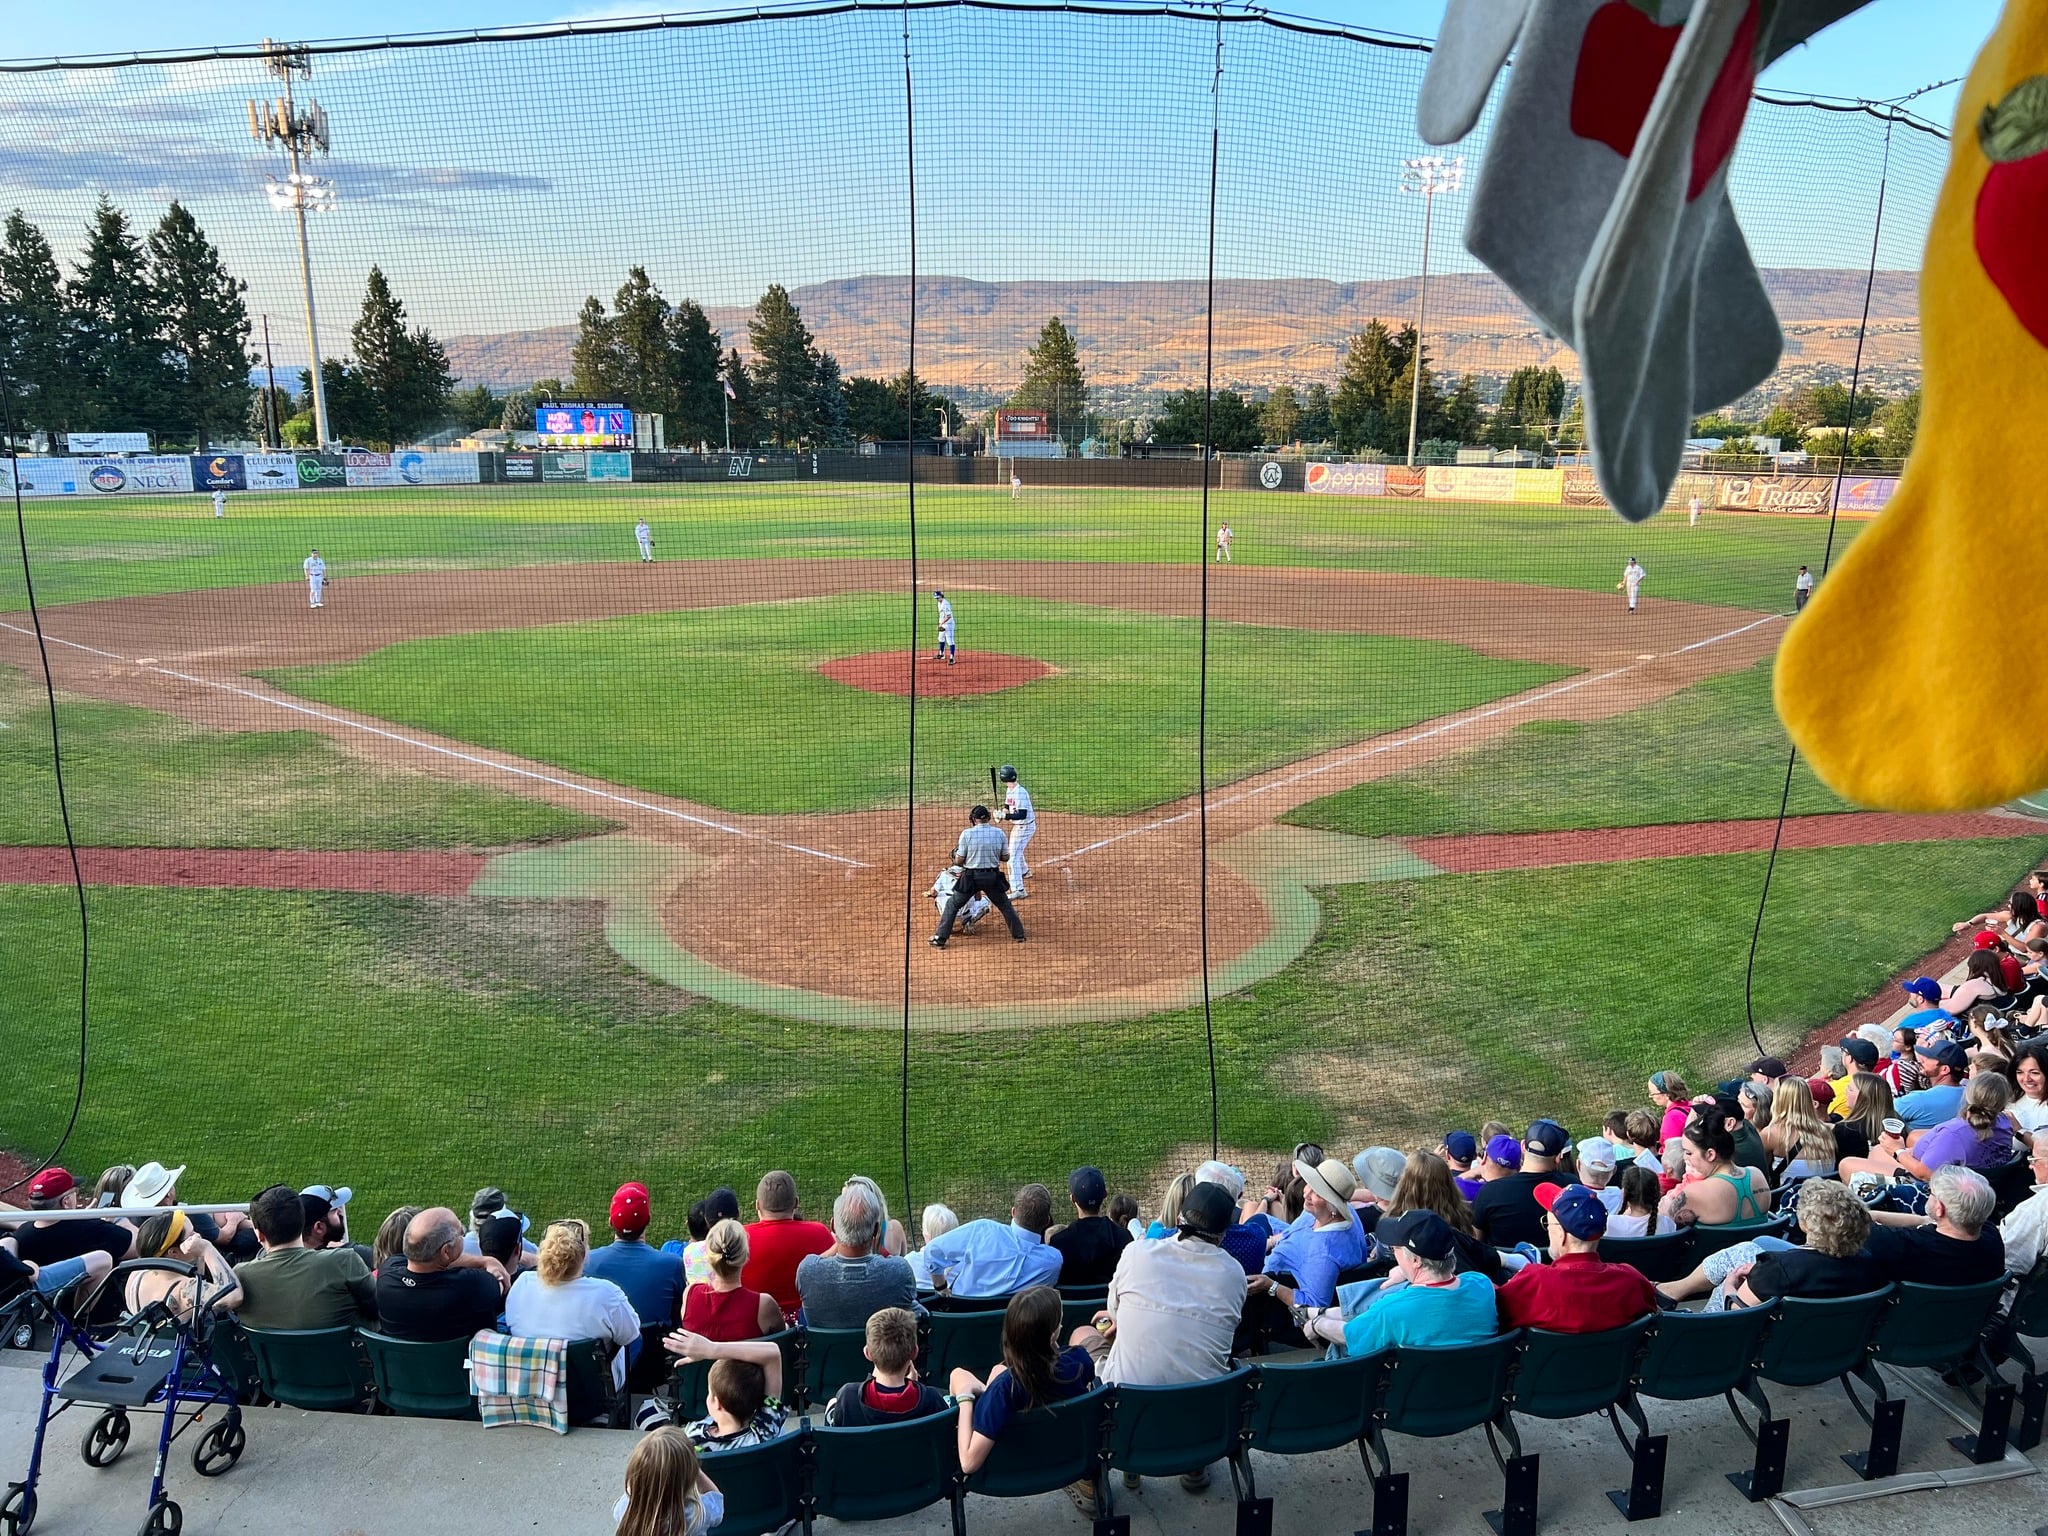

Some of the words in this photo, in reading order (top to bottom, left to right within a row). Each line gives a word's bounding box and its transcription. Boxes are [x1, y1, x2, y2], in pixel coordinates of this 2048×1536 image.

[131, 475, 178, 489] NECA
[1331, 470, 1380, 489] pepsi
[1720, 479, 1752, 506] 12
[1752, 483, 1824, 507] TRIBES
